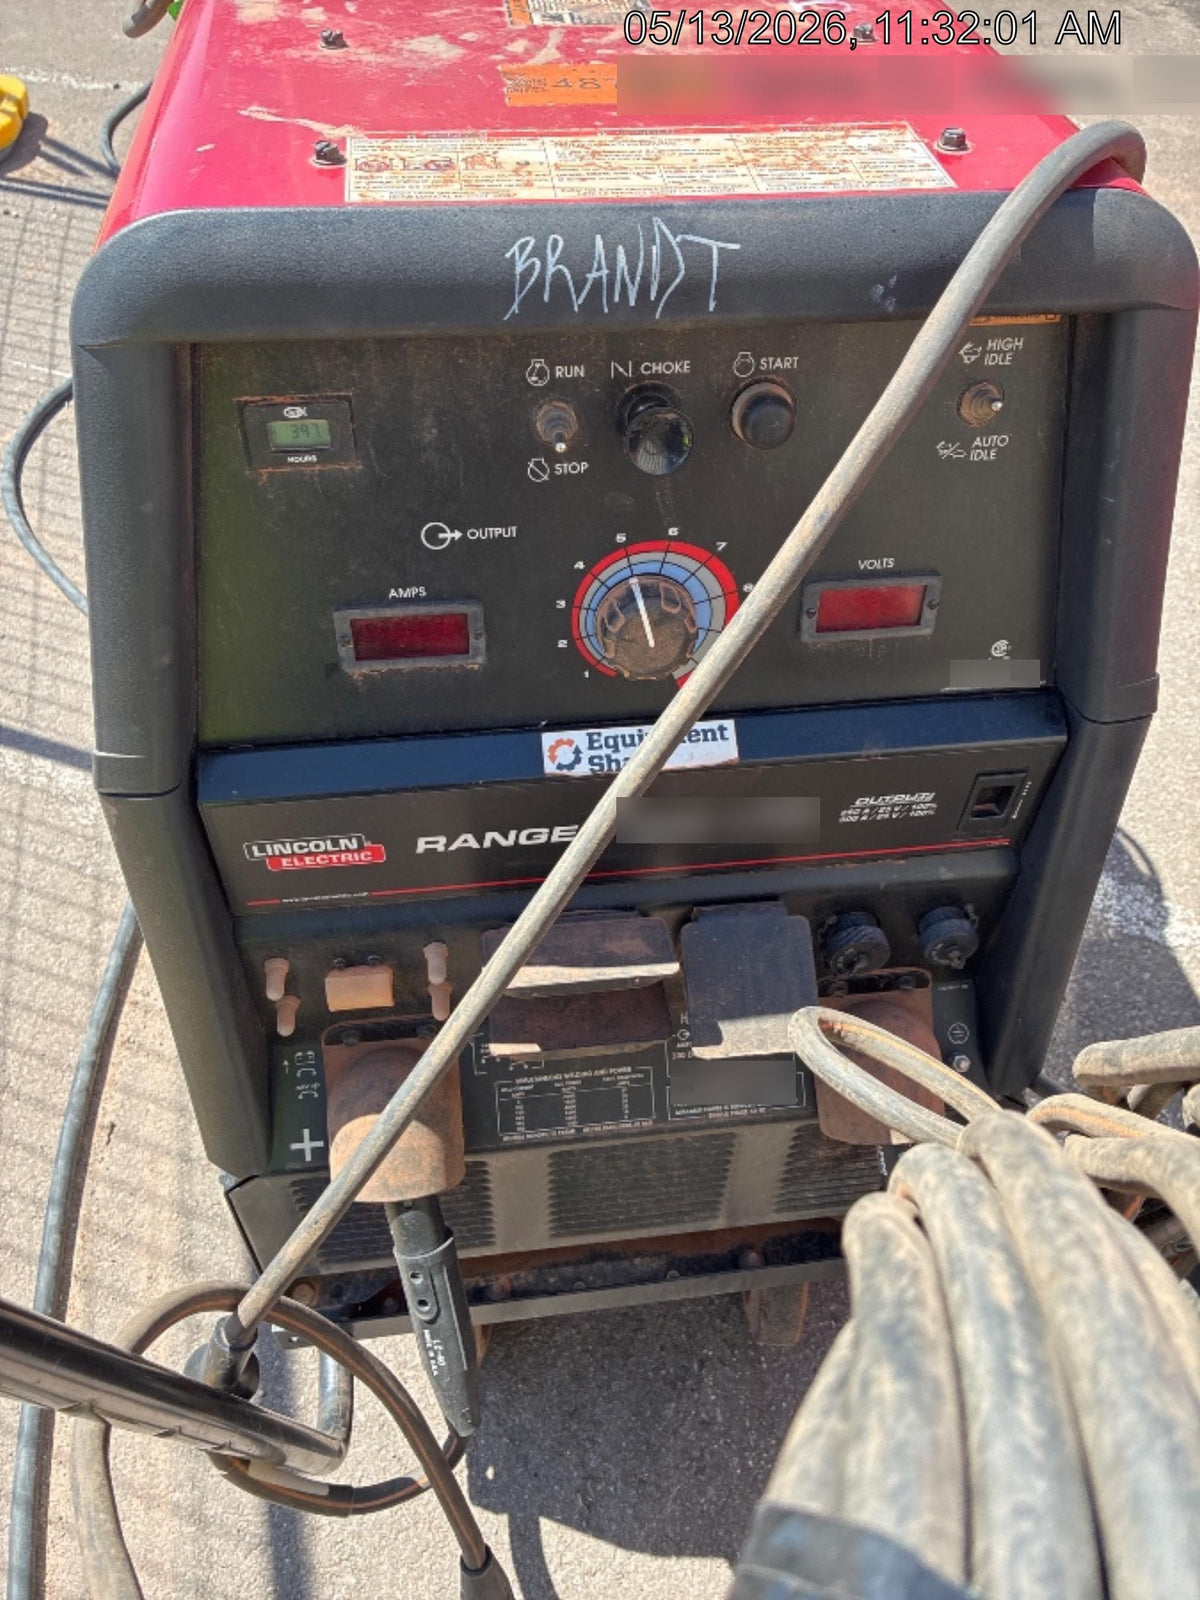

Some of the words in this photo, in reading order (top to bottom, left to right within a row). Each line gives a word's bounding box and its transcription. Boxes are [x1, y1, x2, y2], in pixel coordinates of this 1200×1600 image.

[503, 216, 741, 320] BRANDT
[986, 337, 1025, 351] HIGH
[759, 355, 800, 371] START
[984, 351, 1015, 366] IDLE
[555, 364, 585, 379] RUN
[640, 359, 691, 376] CHOKE
[972, 434, 1009, 448] AUTO
[287, 454, 318, 464] HOURS
[969, 448, 998, 461] IDLE
[554, 461, 590, 476] STOP
[466, 525, 518, 541] OUTPUT
[615, 533, 627, 543] 5
[667, 527, 680, 536] 6
[716, 541, 728, 551] 7
[573, 560, 586, 570] 4
[857, 557, 896, 570] VOLTS
[388, 585, 428, 600] AMPS
[556, 600, 567, 609] 3
[557, 639, 569, 648] 2
[583, 670, 590, 678] 1
[586, 723, 730, 752] Equient
[415, 824, 580, 854] RANGE
[251, 836, 359, 858] LINCOLN
[281, 850, 374, 867] ELECTRIC
